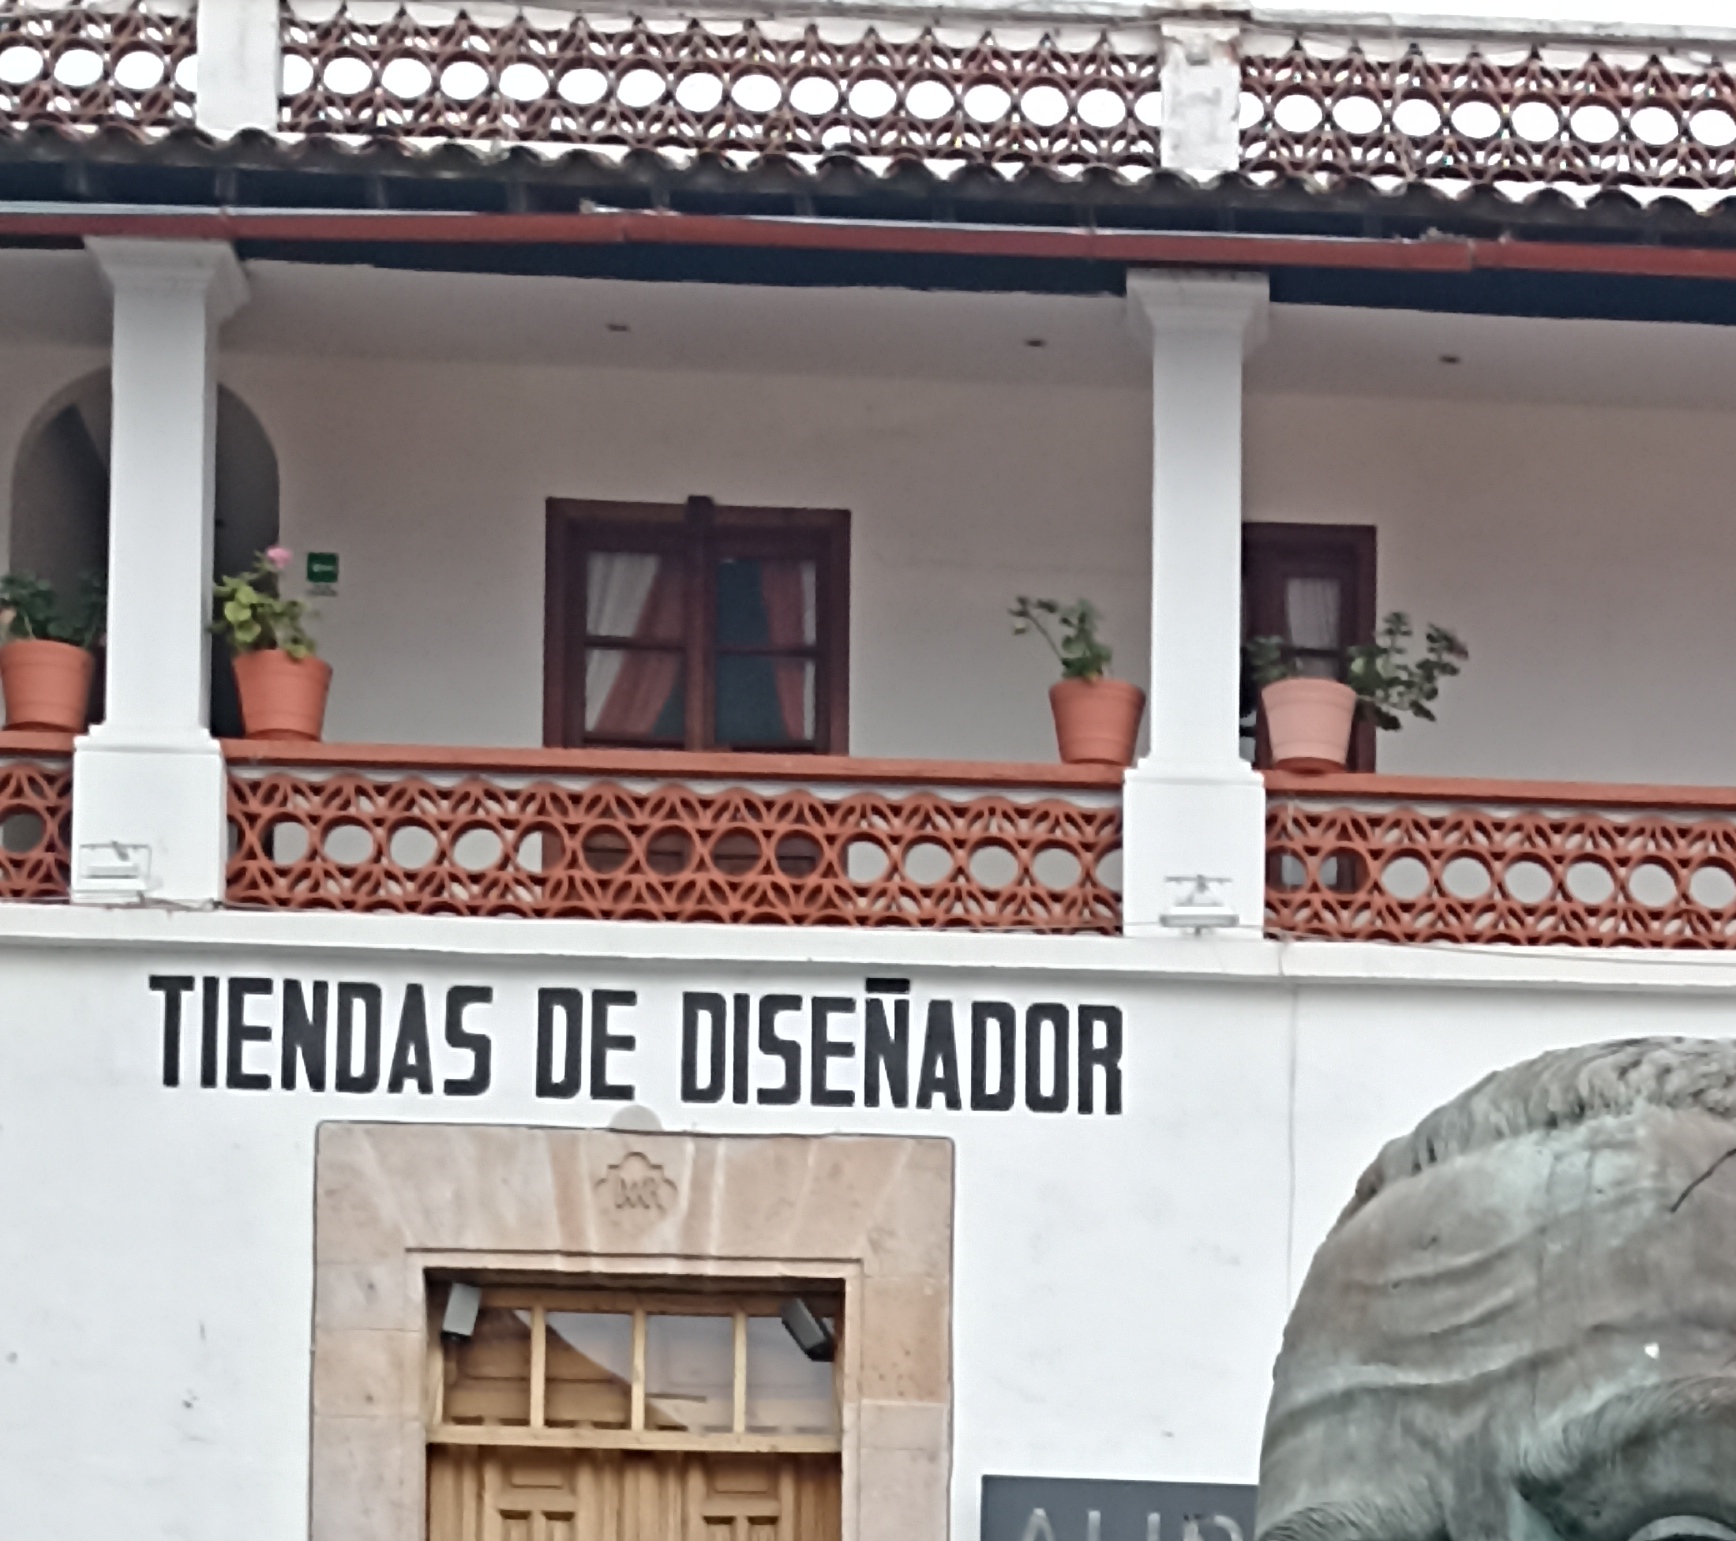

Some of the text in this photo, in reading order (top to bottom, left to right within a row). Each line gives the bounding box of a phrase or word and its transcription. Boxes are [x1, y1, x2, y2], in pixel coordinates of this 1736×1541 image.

[149, 975, 1124, 1116] TIENDAS DE DISEÑADOR
